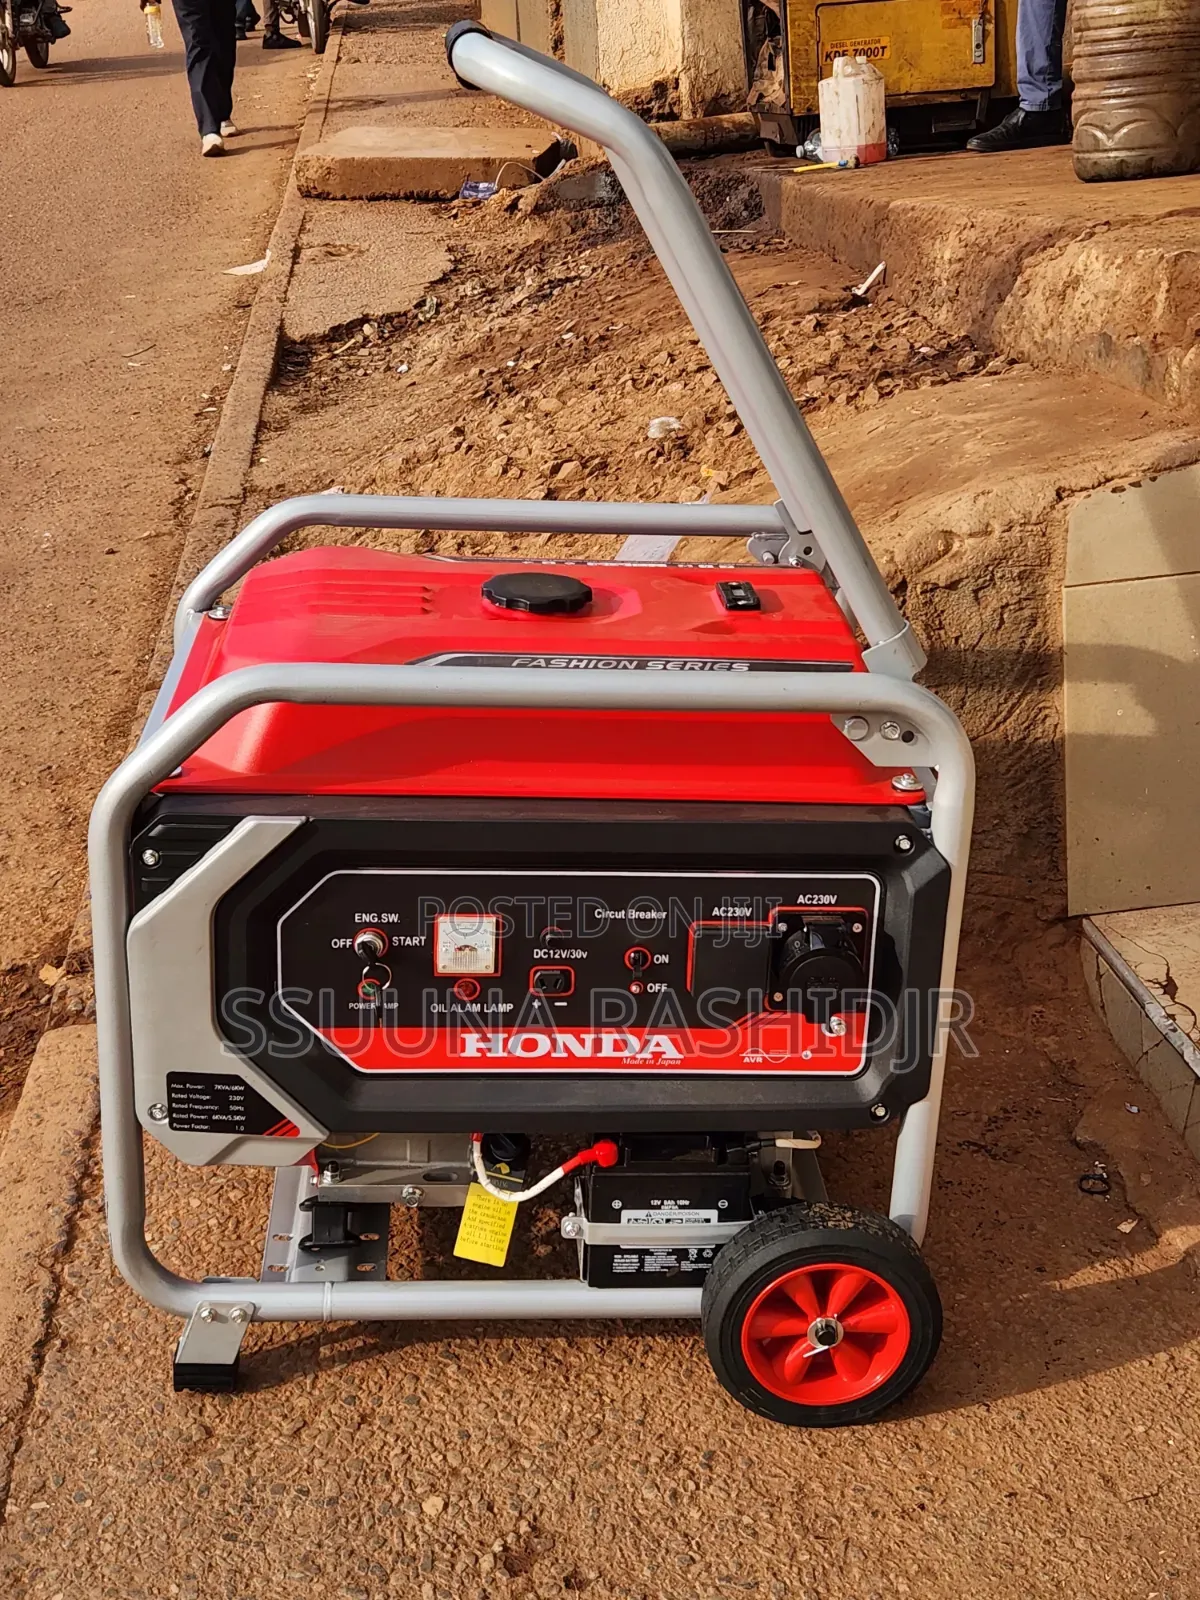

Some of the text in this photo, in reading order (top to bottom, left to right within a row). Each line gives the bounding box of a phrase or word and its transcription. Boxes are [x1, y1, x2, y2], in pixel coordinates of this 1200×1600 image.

[850, 38, 881, 47] GENERATOR
[852, 46, 888, 58] 7000T
[511, 658, 750, 673] FASHION SERIES
[796, 894, 838, 905] AC230V
[354, 912, 401, 923] ENG.SW.
[627, 908, 668, 920] Breaker
[711, 906, 753, 918] AC230V
[331, 938, 353, 949] OFF
[391, 935, 427, 947] START
[533, 948, 588, 960] DC12V/30v
[653, 954, 670, 965] ON
[646, 982, 668, 994] OFF
[348, 1002, 399, 1010] POWER AMP
[430, 1003, 514, 1013] OIL ALAM LAMP
[460, 1033, 685, 1059] HONDA
[621, 1057, 682, 1067] Made in Japan
